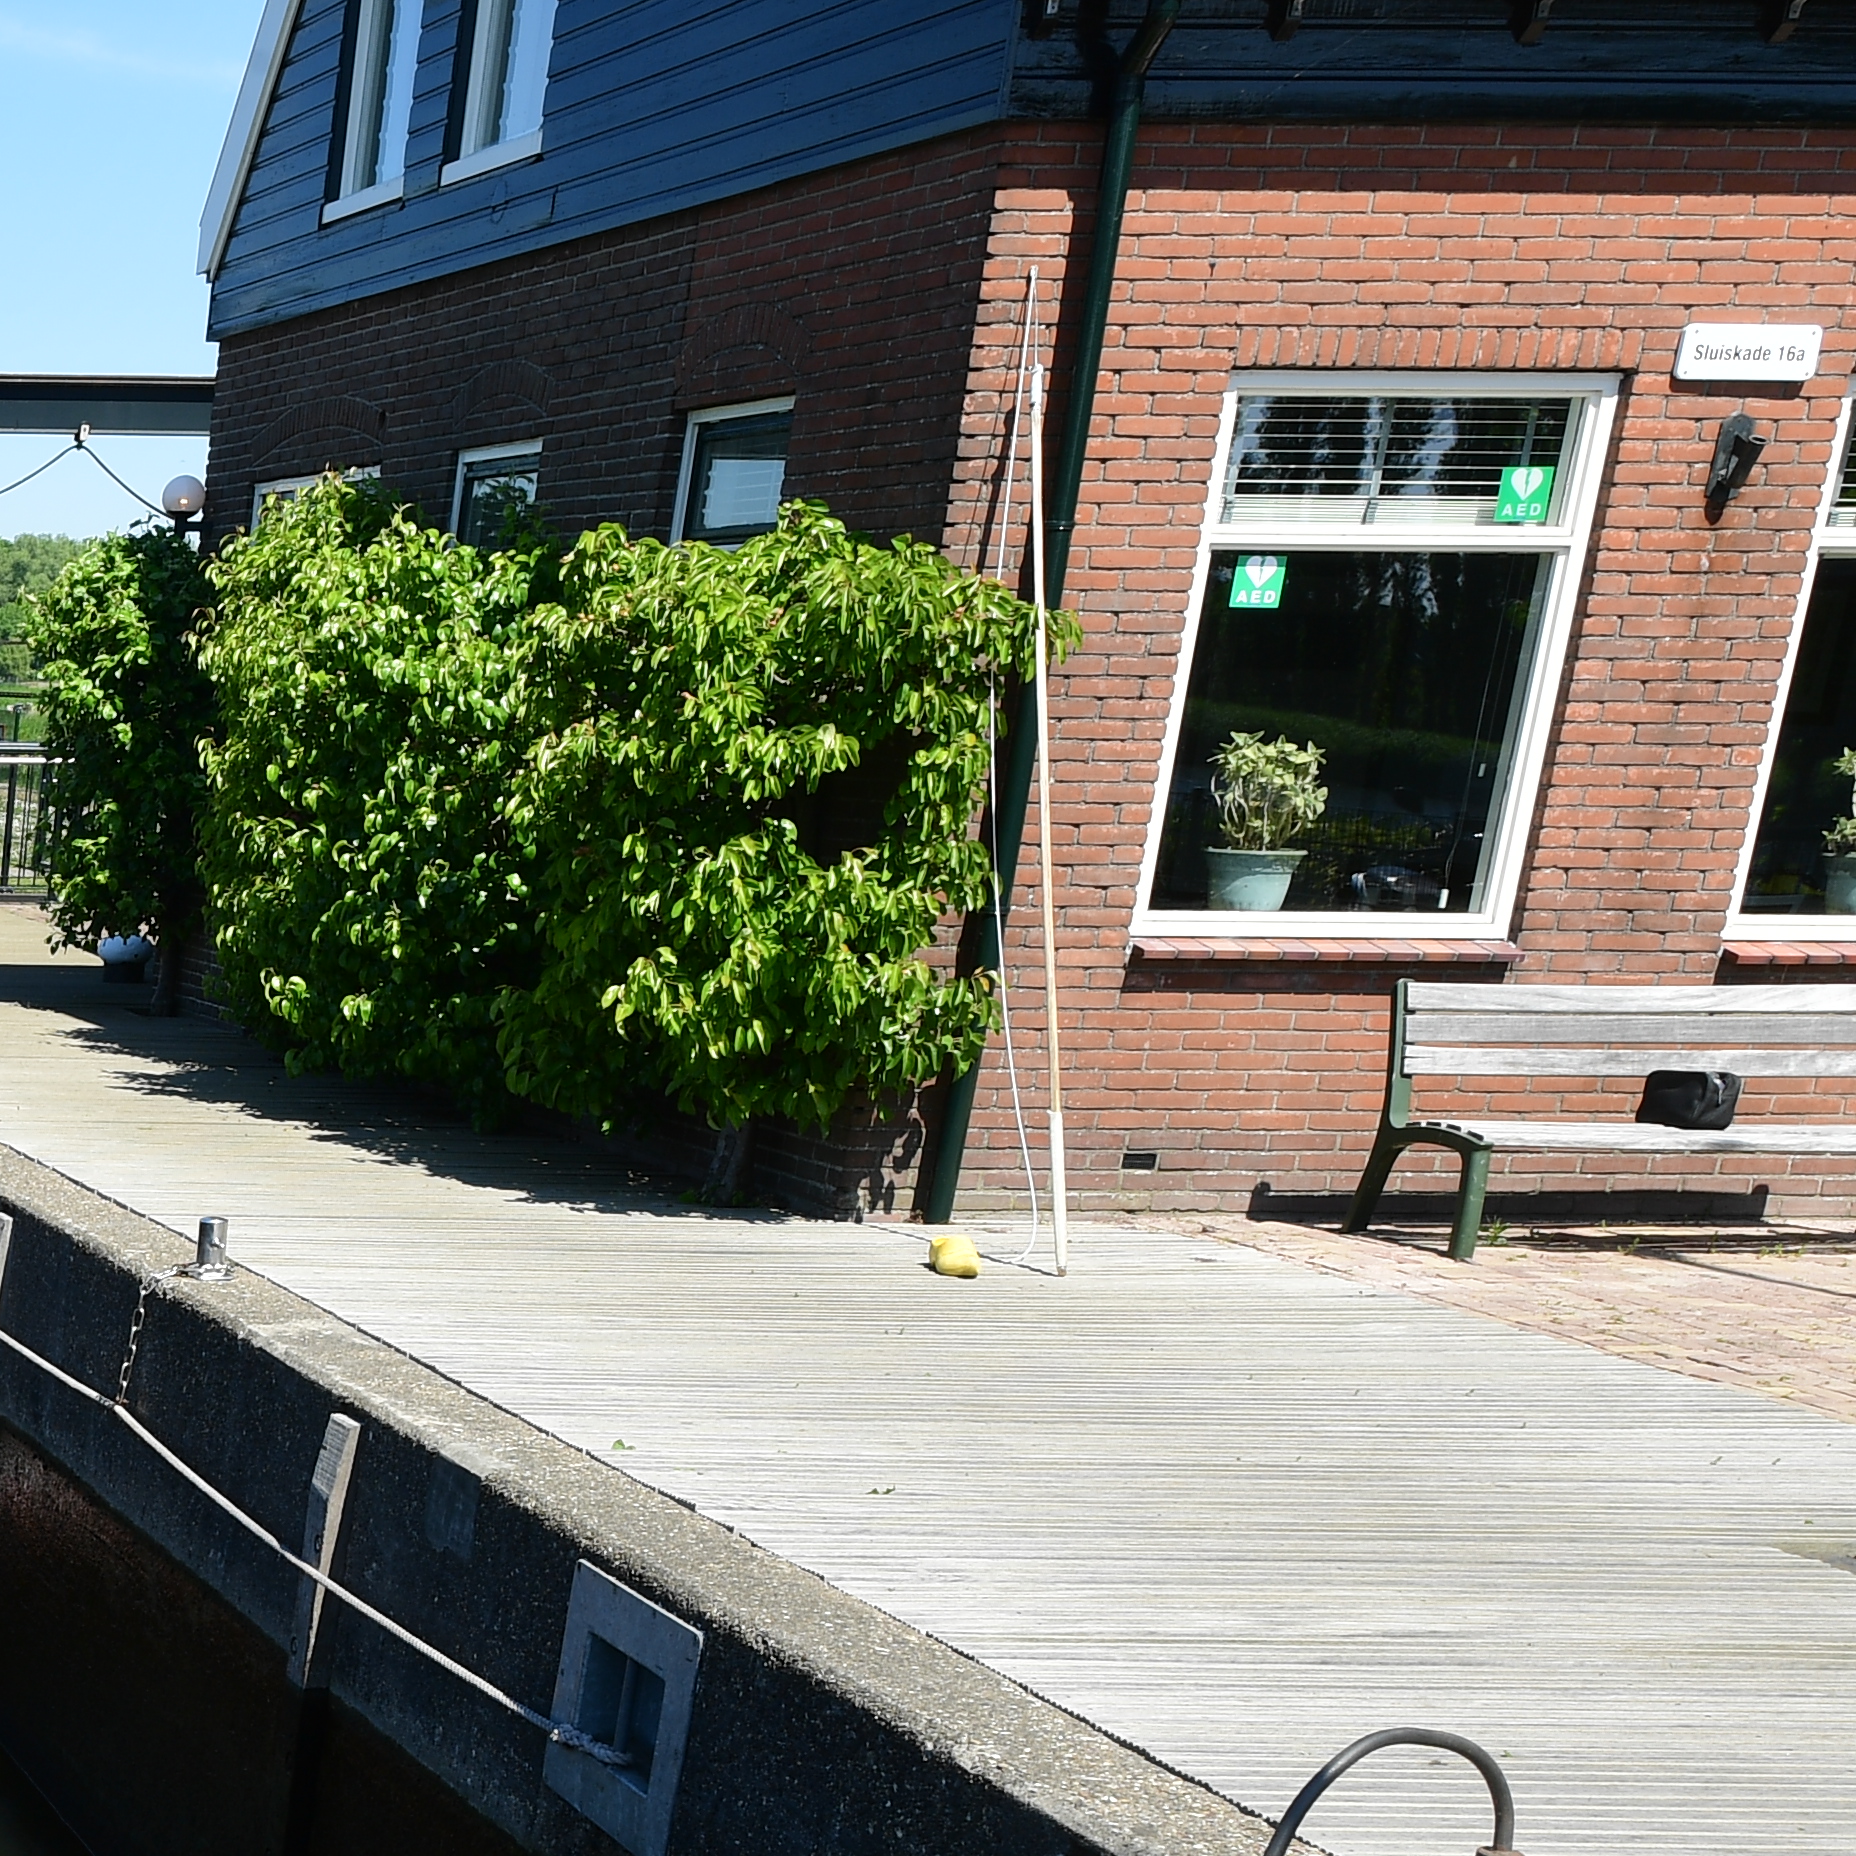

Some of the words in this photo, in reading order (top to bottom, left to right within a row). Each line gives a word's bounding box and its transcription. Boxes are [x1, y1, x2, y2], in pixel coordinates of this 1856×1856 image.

[1693, 344, 1772, 361] Sluiskade
[1778, 345, 1806, 362] 16a
[1501, 503, 1542, 517] AED
[1234, 589, 1276, 604] AED
